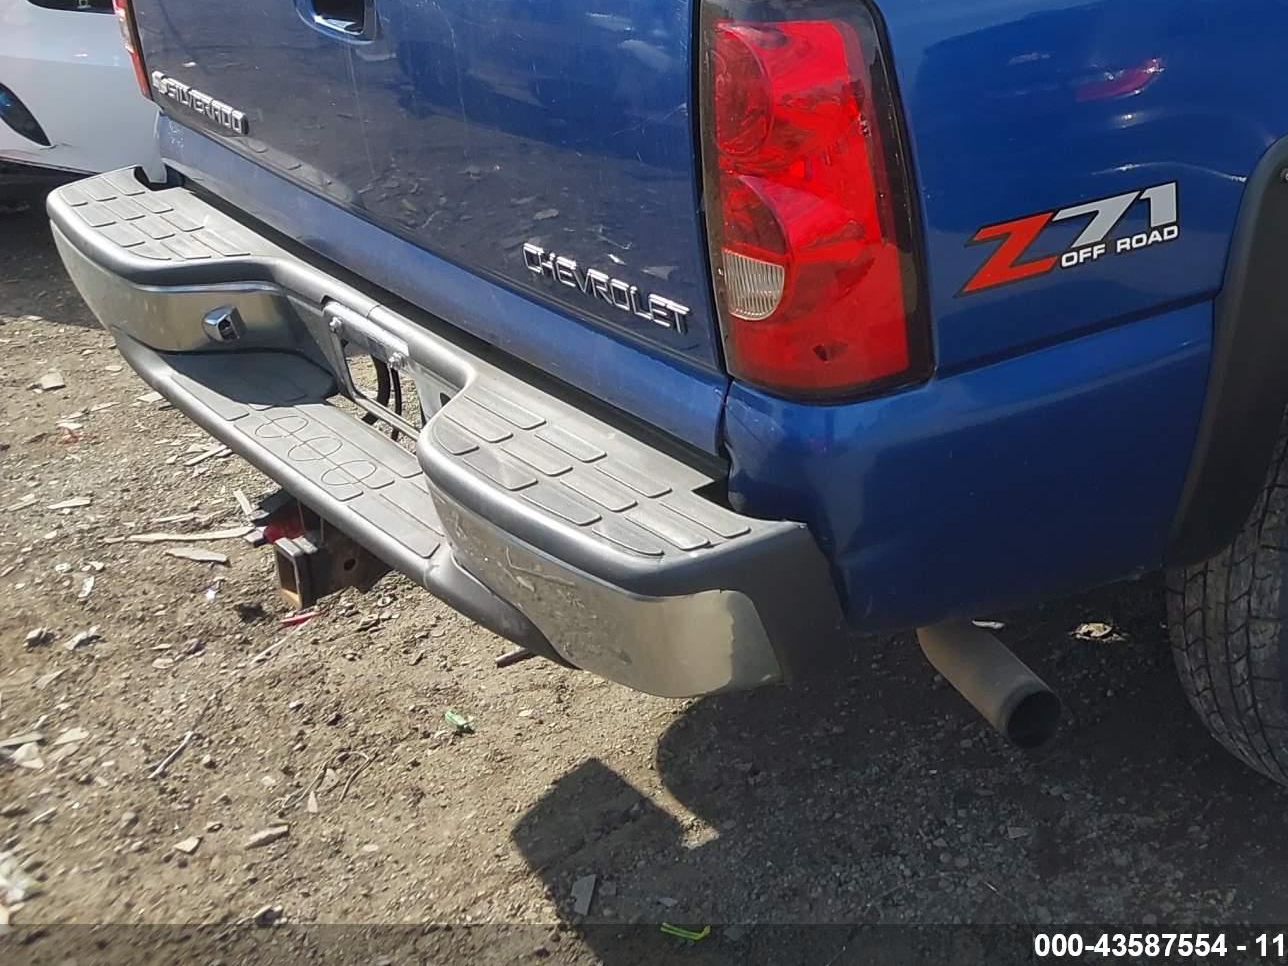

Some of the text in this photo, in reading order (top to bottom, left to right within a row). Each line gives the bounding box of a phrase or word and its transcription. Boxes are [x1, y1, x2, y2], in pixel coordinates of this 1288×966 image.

[953, 181, 1178, 298] Z71
[1060, 225, 1179, 269] OFF ROAD
[522, 242, 691, 334] CHEVROLET
